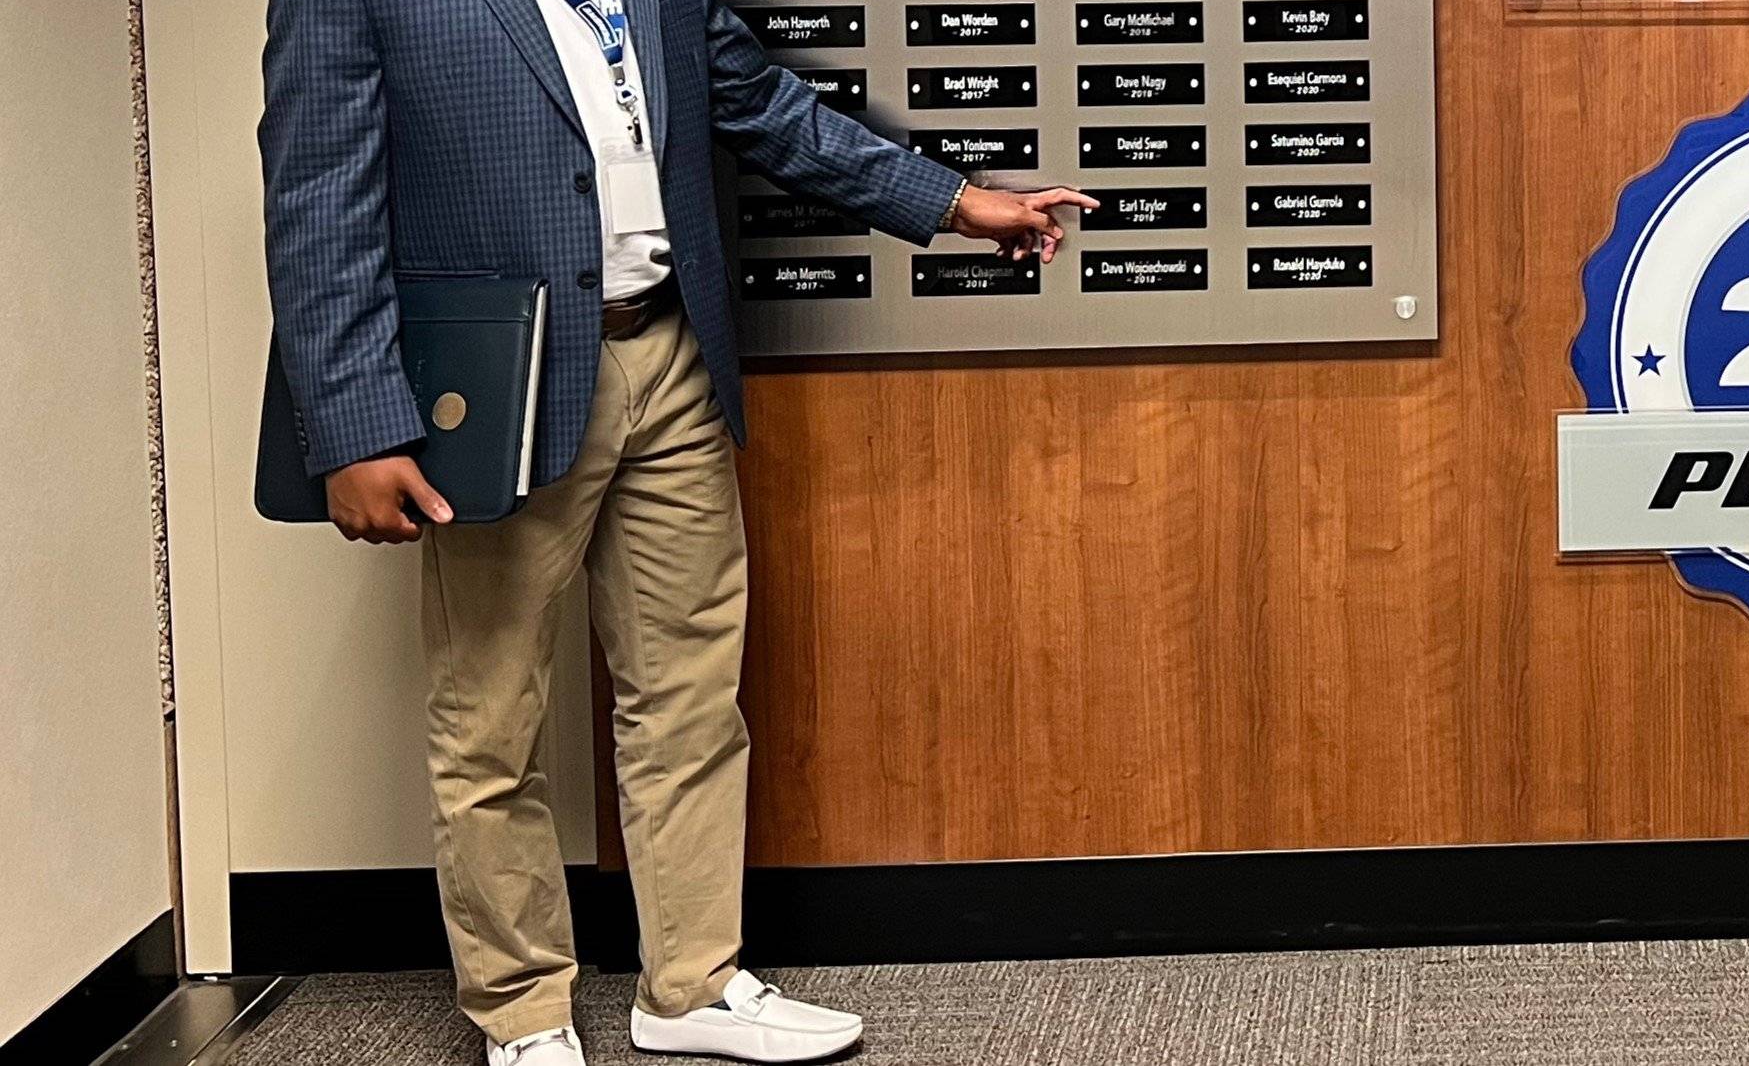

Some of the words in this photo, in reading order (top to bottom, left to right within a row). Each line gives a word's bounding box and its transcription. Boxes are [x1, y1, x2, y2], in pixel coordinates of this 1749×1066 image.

[767, 15, 789, 30] John
[790, 15, 830, 30] Haworth
[941, 13, 960, 27] Dan
[961, 13, 998, 27] Worden
[1282, 10, 1308, 23] Kevin
[1309, 9, 1330, 26] Baty
[805, 79, 839, 92] hnson
[944, 76, 966, 91] Brad
[966, 75, 999, 92] Wright
[1115, 75, 1140, 88] Dave
[1141, 75, 1167, 91] Nagy
[941, 138, 961, 152] Don
[1117, 136, 1143, 150] David
[1144, 136, 1168, 150] Swan
[1119, 200, 1138, 212] Earl
[1139, 199, 1167, 216] Taylor
[1274, 195, 1308, 209] Gabriel
[1273, 257, 1305, 272] Ronald
[775, 267, 798, 281] John
